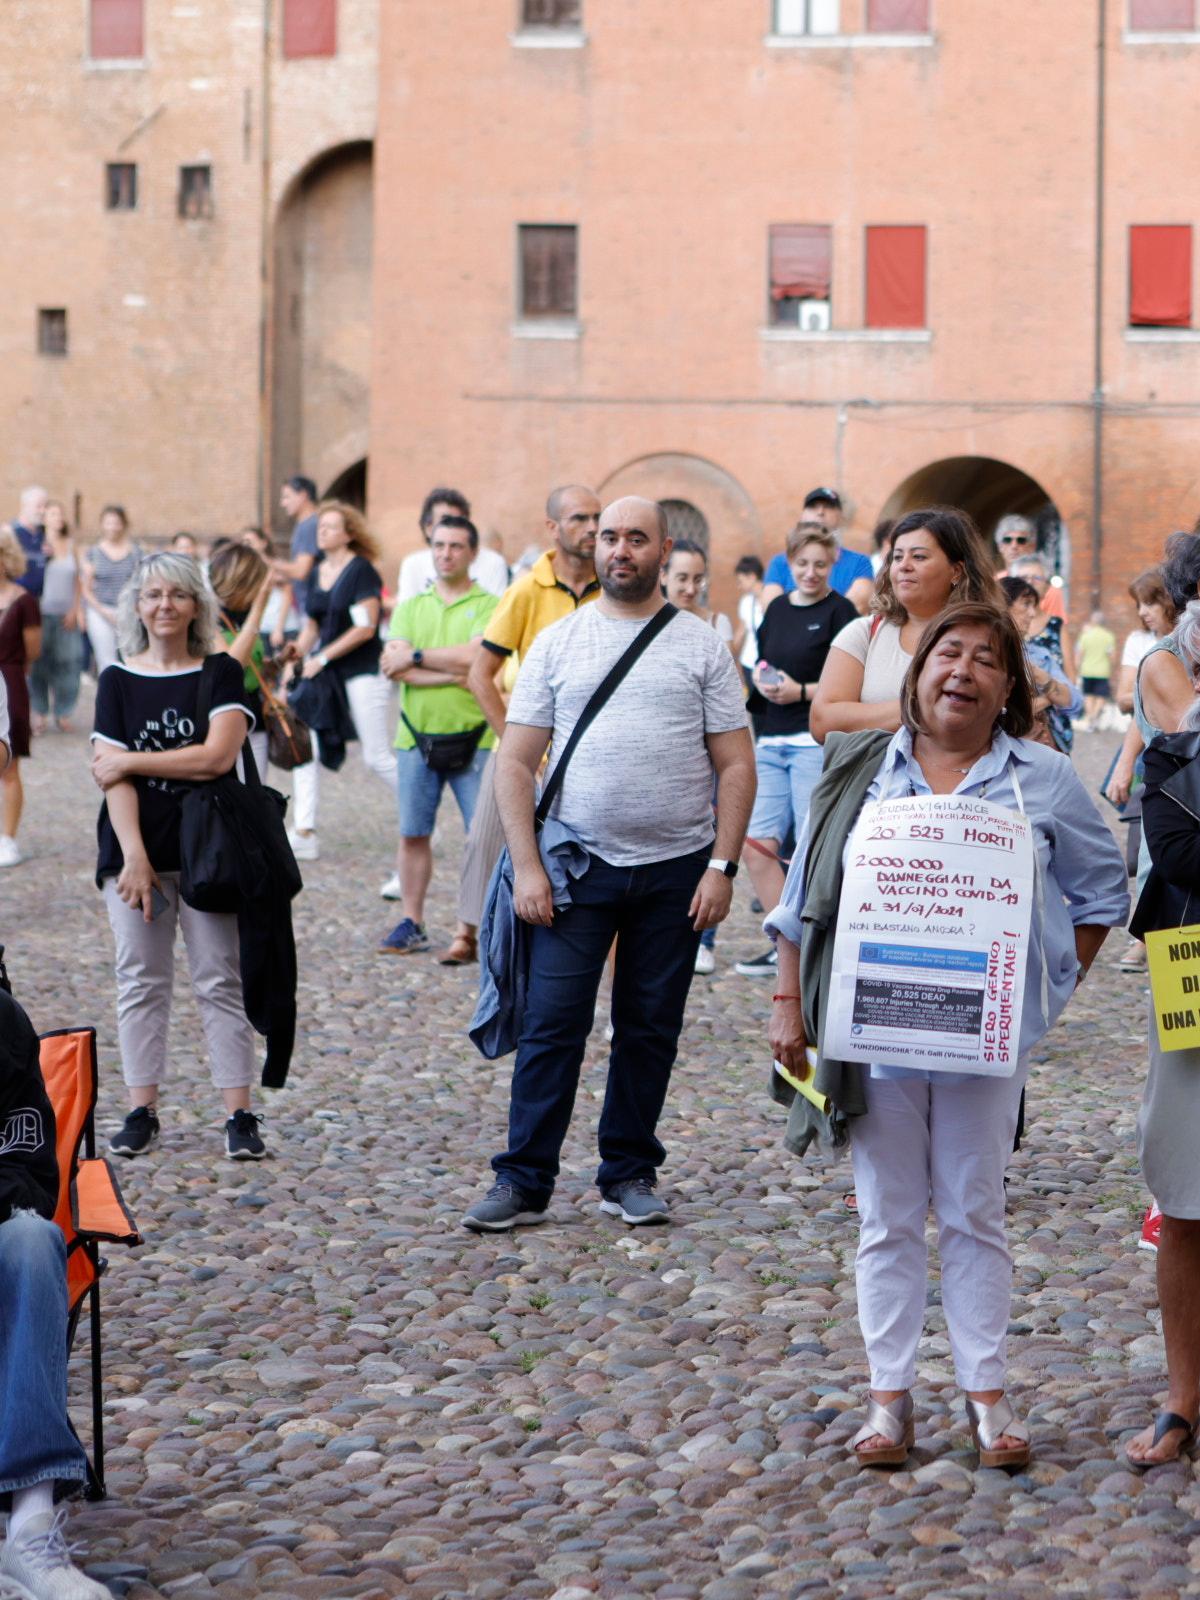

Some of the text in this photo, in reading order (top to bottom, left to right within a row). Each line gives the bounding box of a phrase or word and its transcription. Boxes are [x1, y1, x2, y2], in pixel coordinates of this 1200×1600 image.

[910, 825, 944, 840] 525
[876, 871, 1012, 890] DANNEGGIATI DA
[878, 884, 948, 898] VACCINO
[859, 902, 876, 912] AL
[849, 922, 868, 931] NON
[924, 925, 964, 935] ANCORA
[1182, 976, 1200, 994] DI
[921, 993, 946, 1001] DEAD
[1162, 1010, 1196, 1031] UNA
[984, 1011, 996, 1062] SIERO
